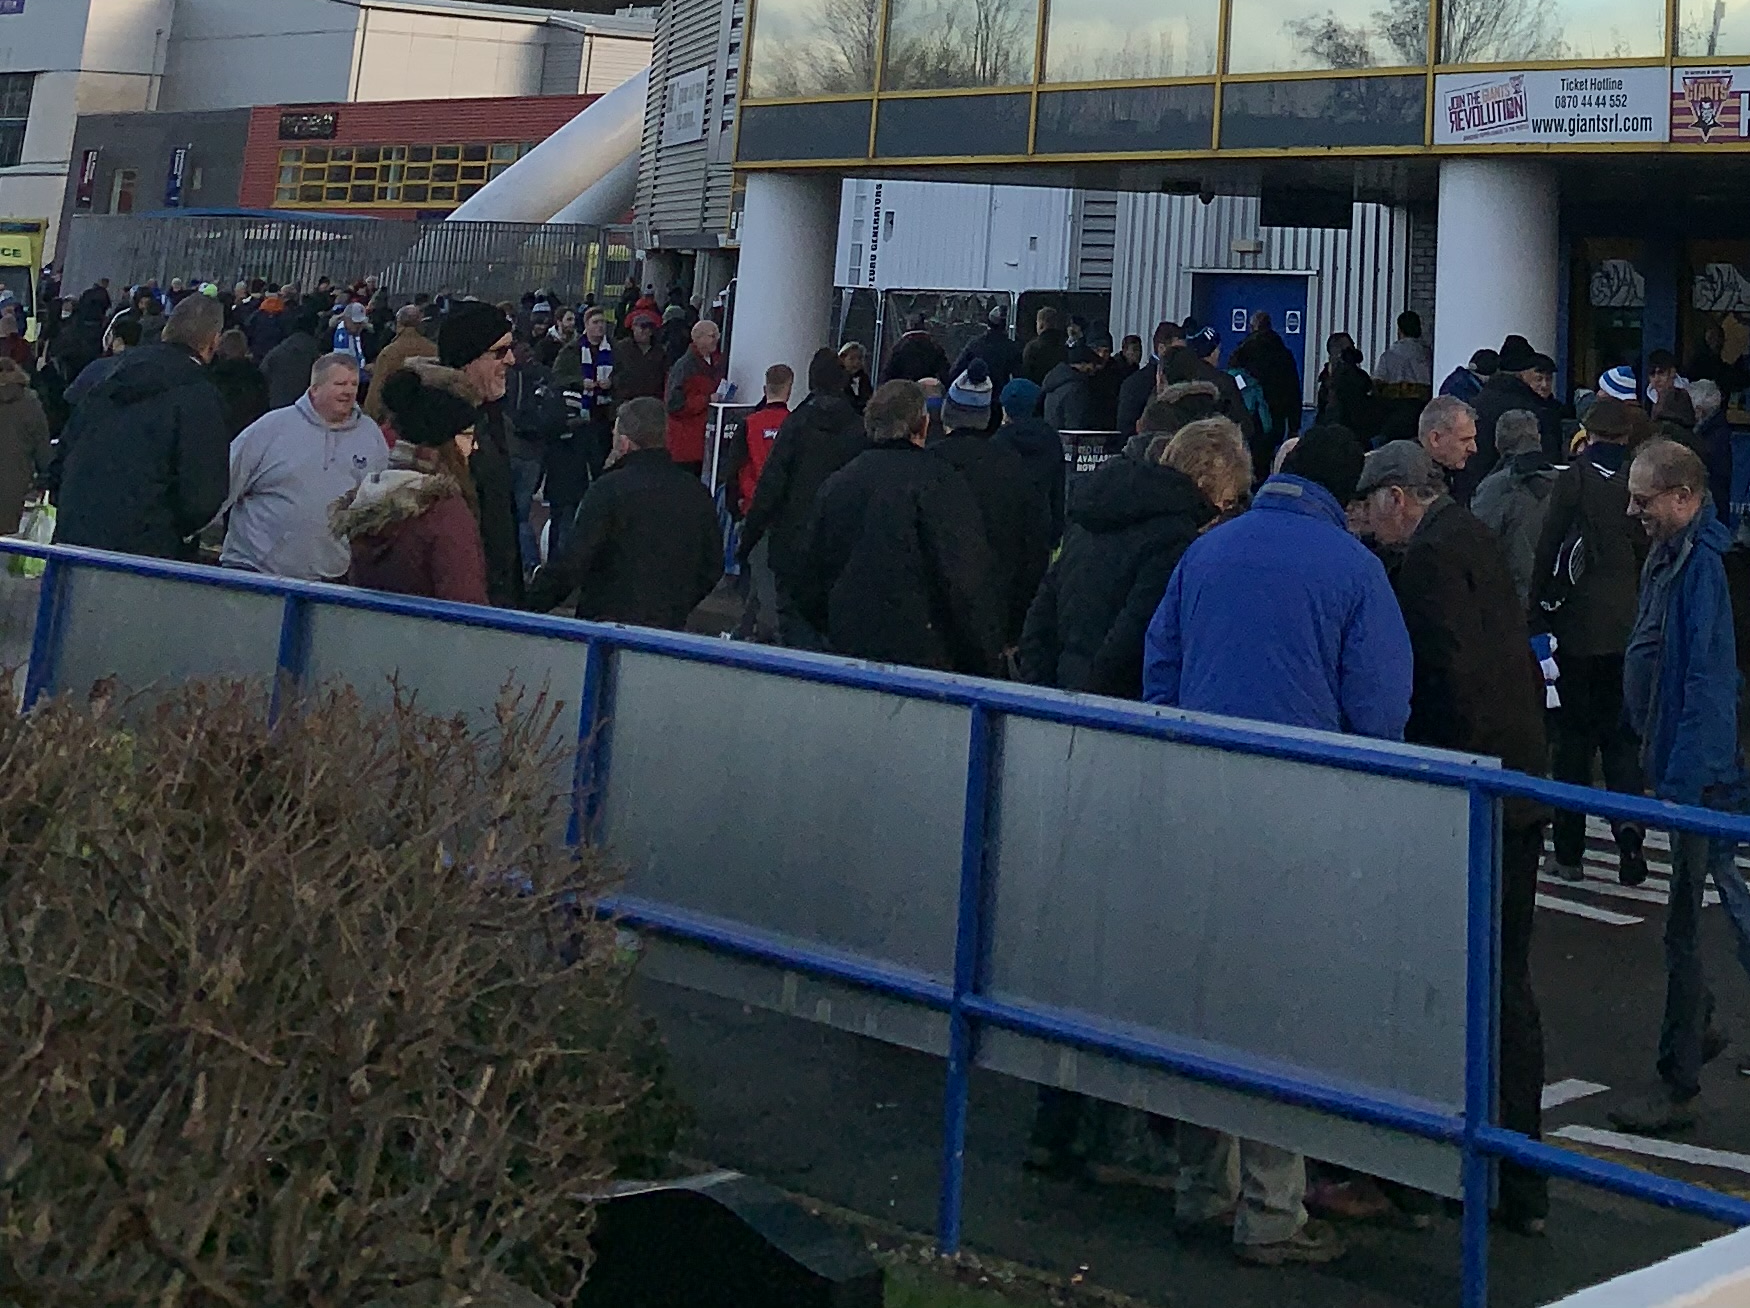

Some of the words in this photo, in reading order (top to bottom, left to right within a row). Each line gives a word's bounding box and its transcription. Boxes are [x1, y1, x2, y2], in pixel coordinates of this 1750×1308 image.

[1560, 77, 1588, 92] Ticket
[1590, 77, 1623, 91] Hotline
[1448, 95, 1466, 112] JOIN
[1467, 91, 1482, 108] THE
[1482, 82, 1511, 103] GIANTS
[1554, 95, 1578, 109] 0870
[1581, 95, 1592, 108] 44
[1594, 95, 1606, 108] 44
[1609, 94, 1628, 108] 552
[1531, 113, 1653, 137] www.giantsrl.com
